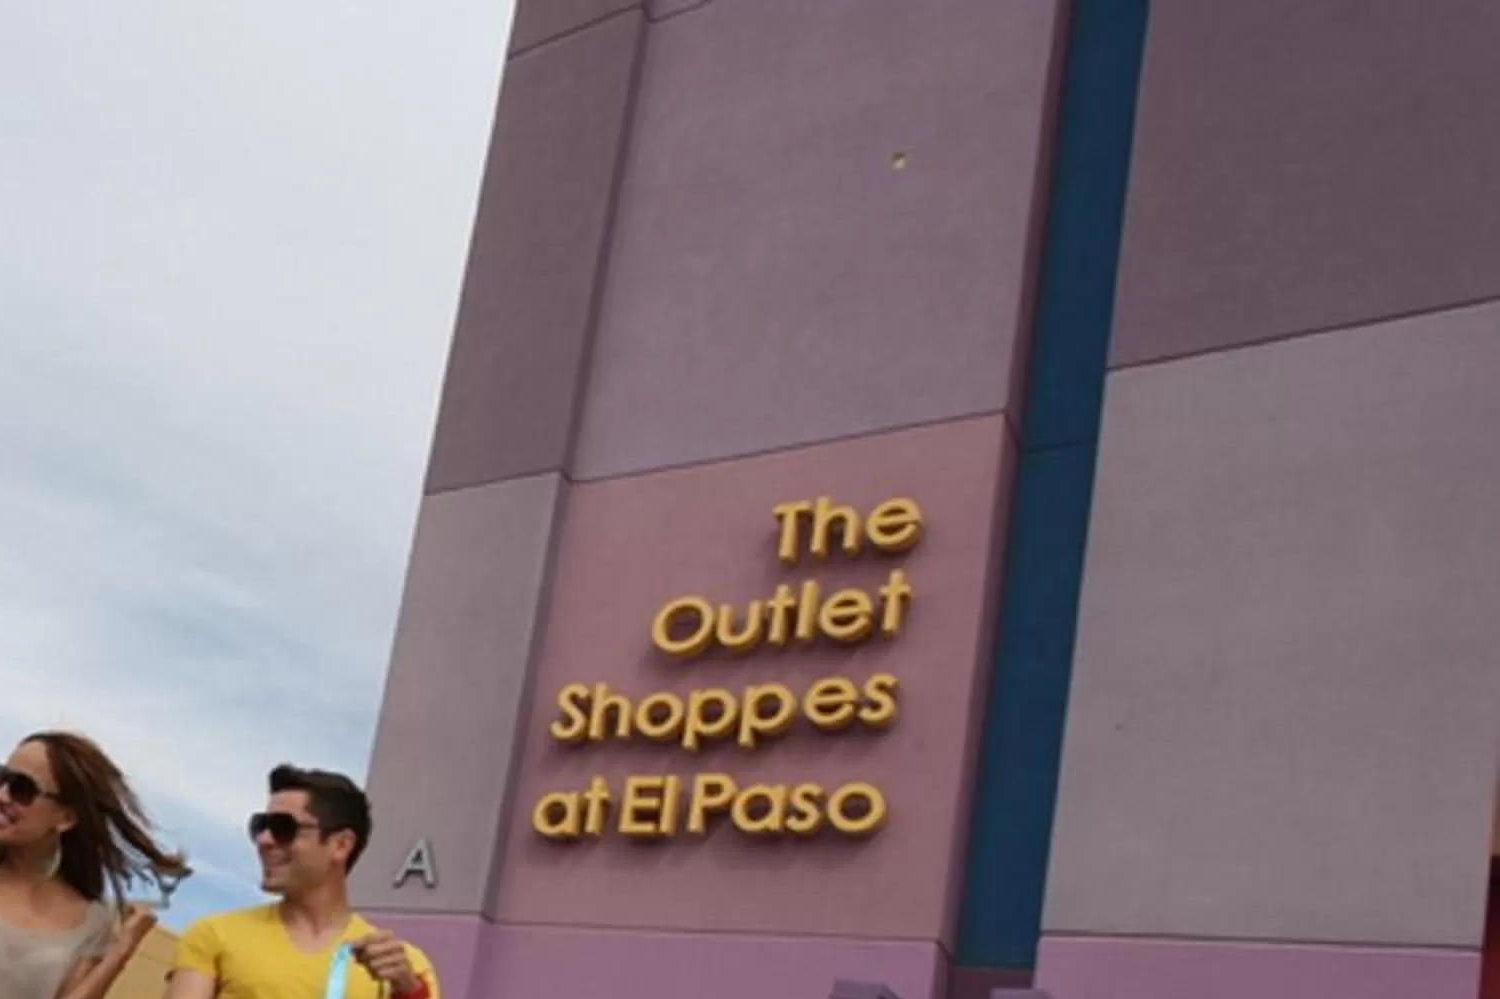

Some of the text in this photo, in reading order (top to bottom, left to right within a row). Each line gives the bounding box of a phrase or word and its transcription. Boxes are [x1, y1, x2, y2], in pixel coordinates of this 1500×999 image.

[773, 496, 924, 561] The
[652, 569, 912, 657] Outlet
[550, 672, 898, 750] Shoppes
[532, 772, 887, 838] at El Paso
[393, 838, 437, 888] A
